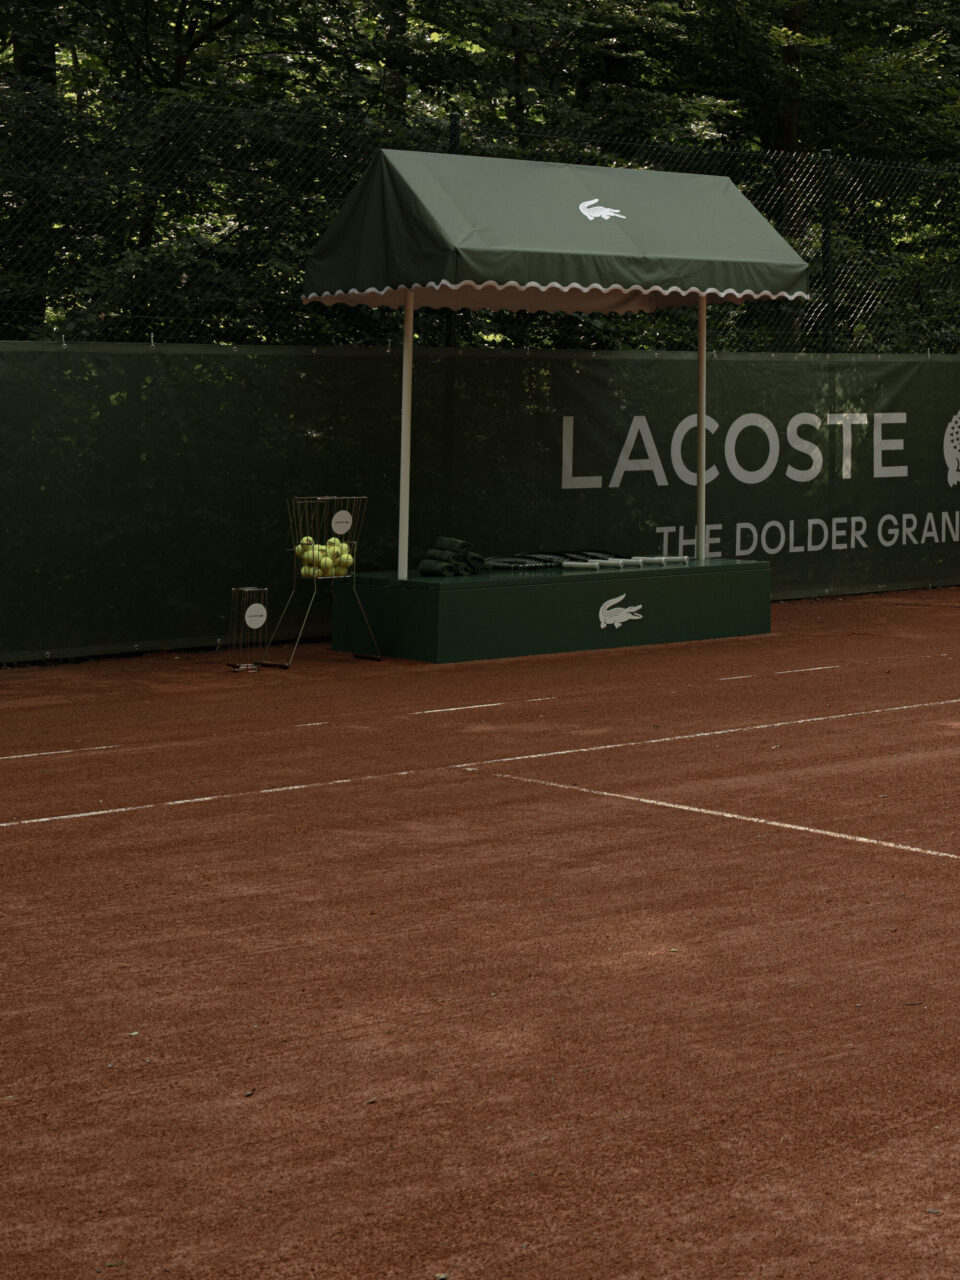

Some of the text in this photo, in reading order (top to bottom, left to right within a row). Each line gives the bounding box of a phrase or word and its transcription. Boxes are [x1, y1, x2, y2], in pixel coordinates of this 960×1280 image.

[561, 412, 908, 489] LACOSTE
[656, 524, 723, 559] THE
[735, 516, 869, 557] DOLDER
